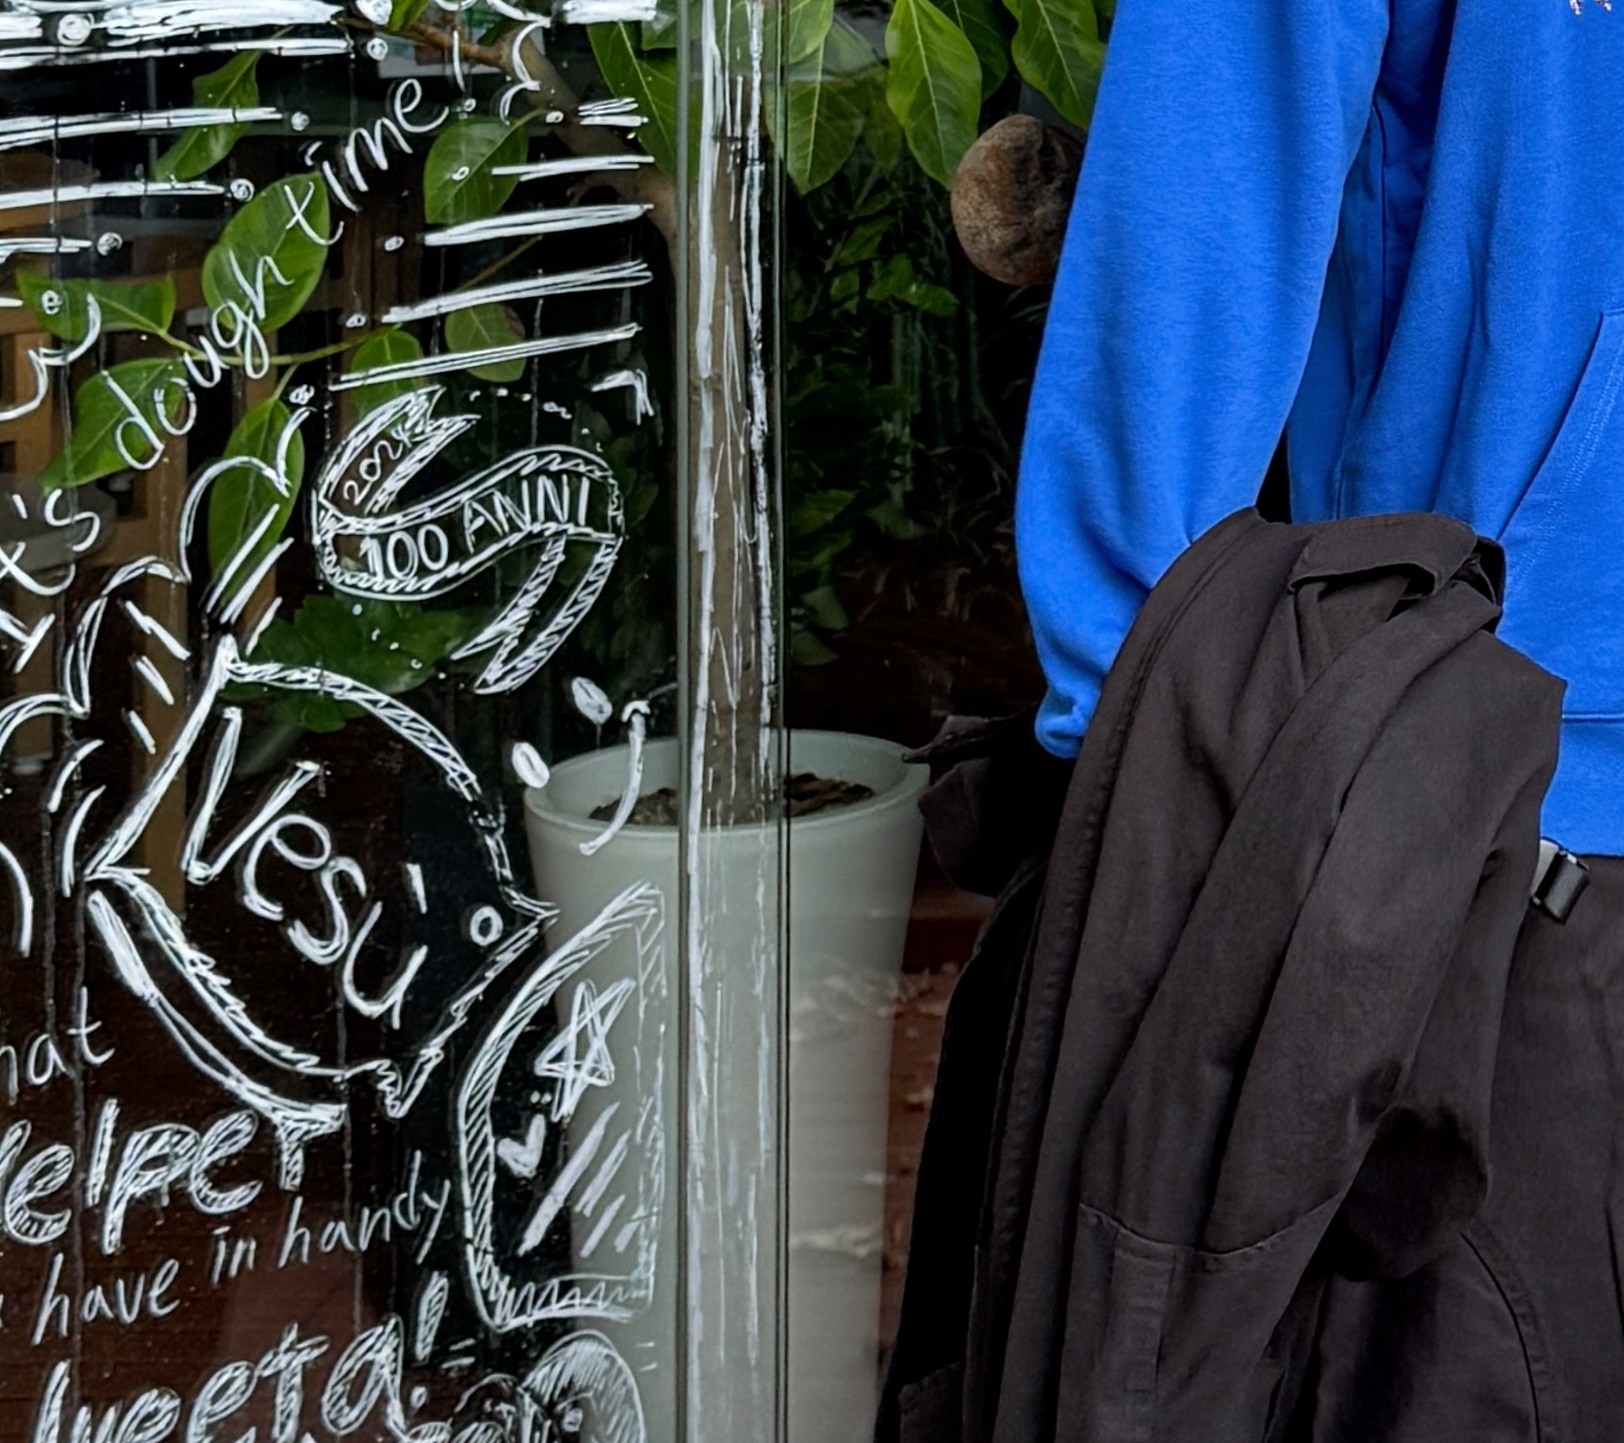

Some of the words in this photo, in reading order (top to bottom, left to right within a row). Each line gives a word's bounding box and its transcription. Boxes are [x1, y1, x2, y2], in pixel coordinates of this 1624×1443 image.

[103, 249, 293, 470] dough
[285, 77, 448, 245] time
[31, 1253, 179, 1345] have
[212, 1226, 256, 1284] in
[279, 1151, 449, 1268] handy
